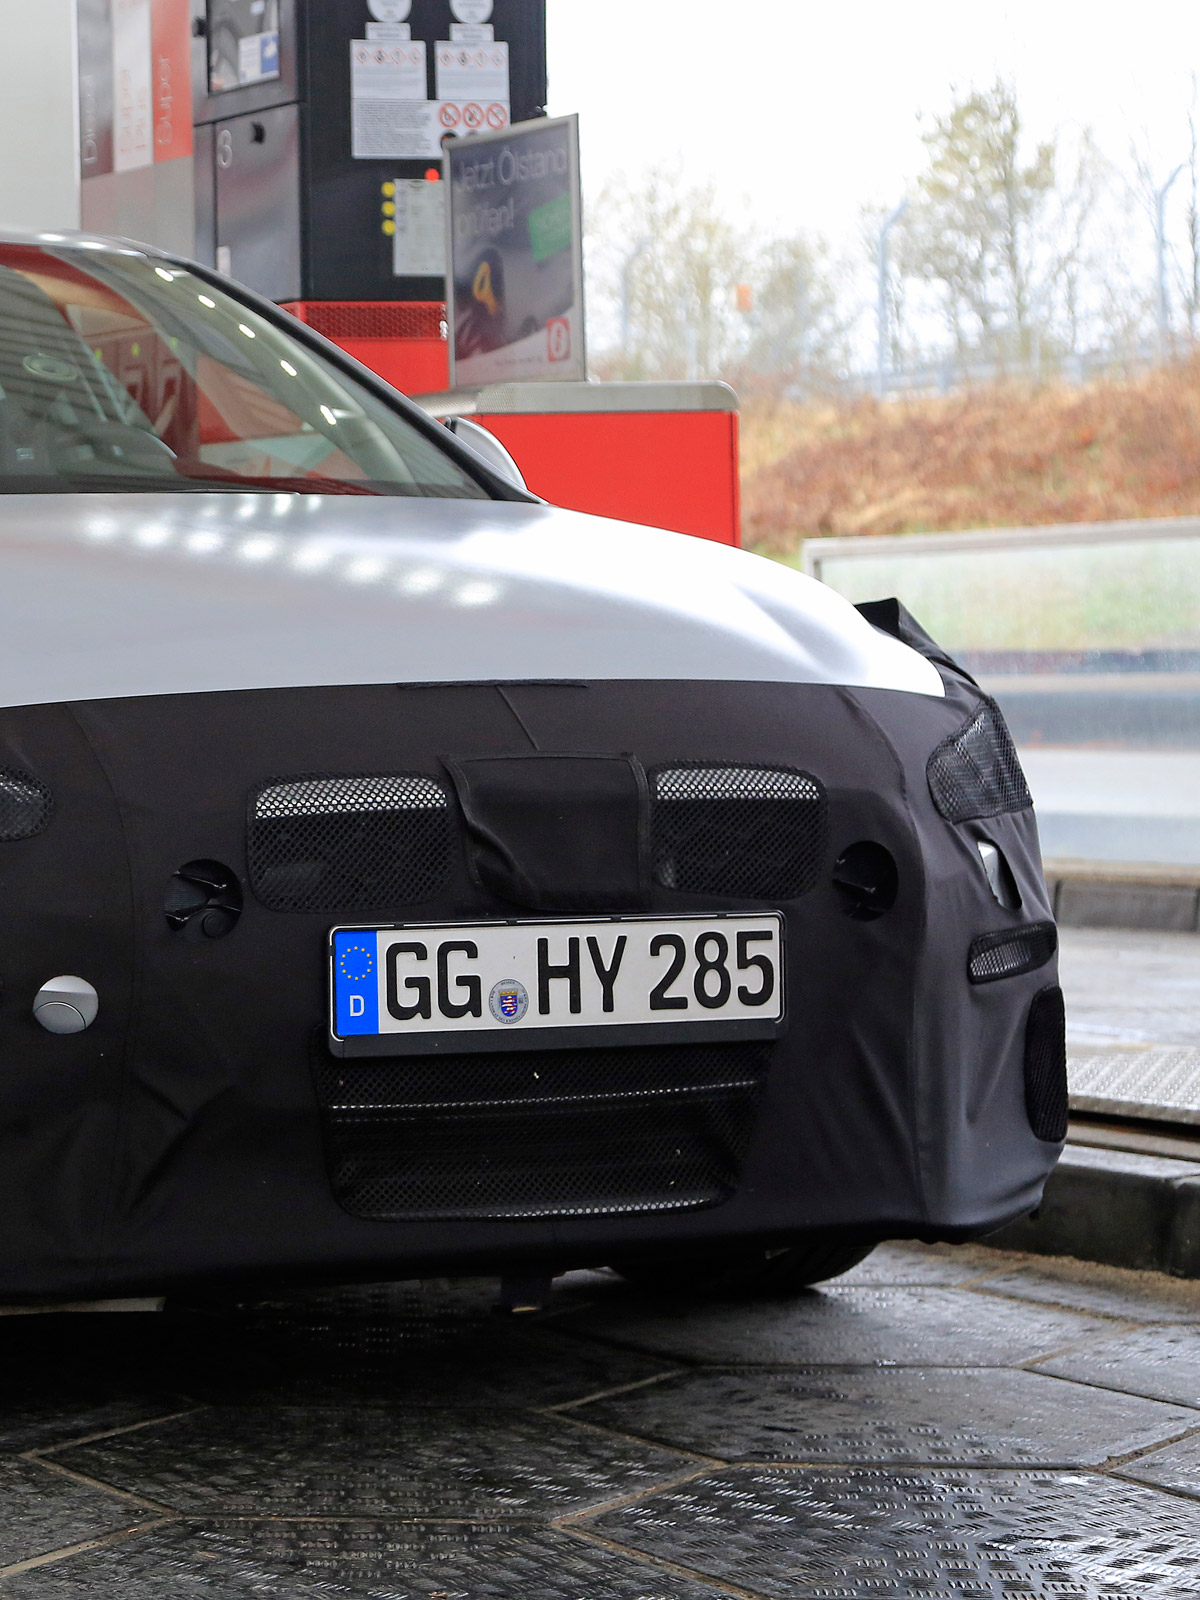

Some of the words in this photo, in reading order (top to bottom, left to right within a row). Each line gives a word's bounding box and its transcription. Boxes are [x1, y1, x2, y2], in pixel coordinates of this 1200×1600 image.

[157, 55, 173, 145] Super
[499, 140, 567, 186] Ölstand
[349, 994, 365, 1017] D
[385, 940, 482, 1020] GG
[537, 935, 627, 1014] HY
[649, 930, 774, 1010] 285
